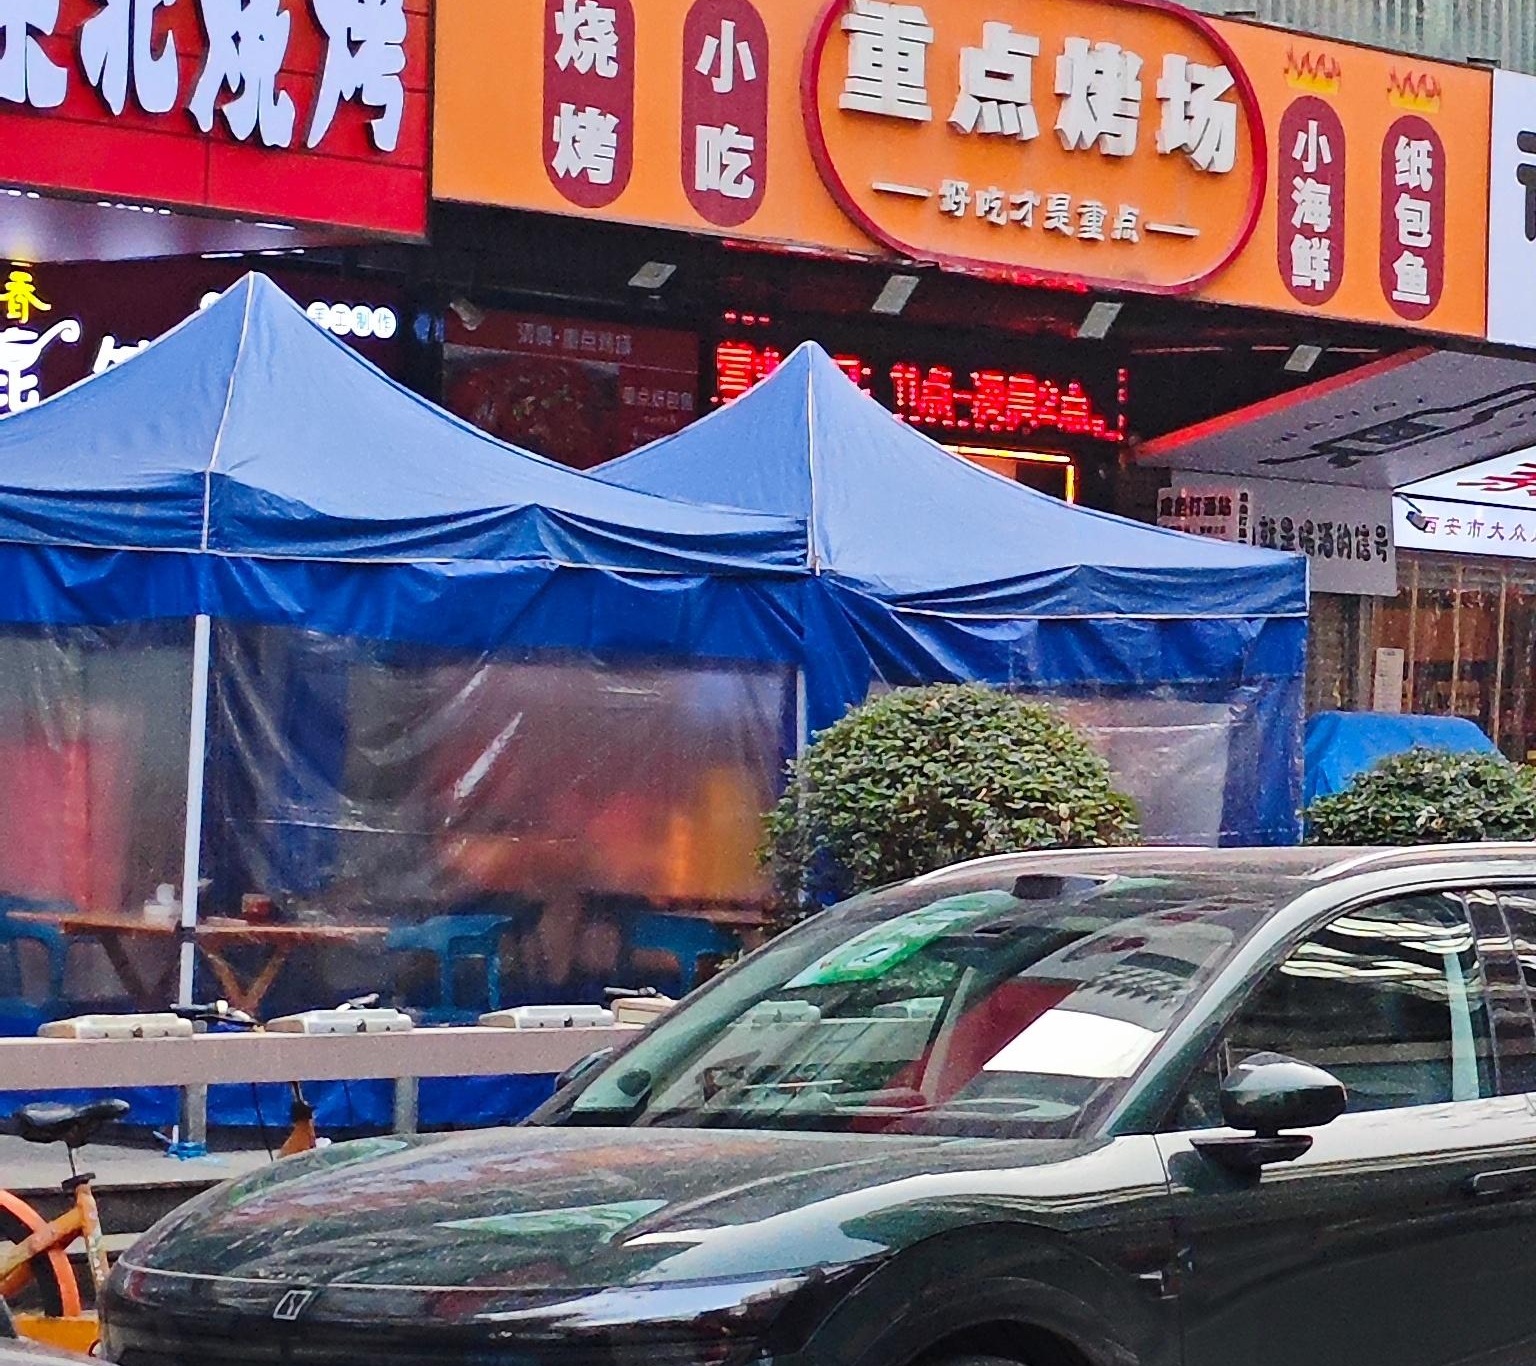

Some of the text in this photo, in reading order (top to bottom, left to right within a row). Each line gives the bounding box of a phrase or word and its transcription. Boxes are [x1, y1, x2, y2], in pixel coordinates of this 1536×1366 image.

[695, 19, 757, 201] 小吃
[1289, 119, 1335, 290] 小海鲜
[1392, 136, 1433, 308] 纸包鱼
